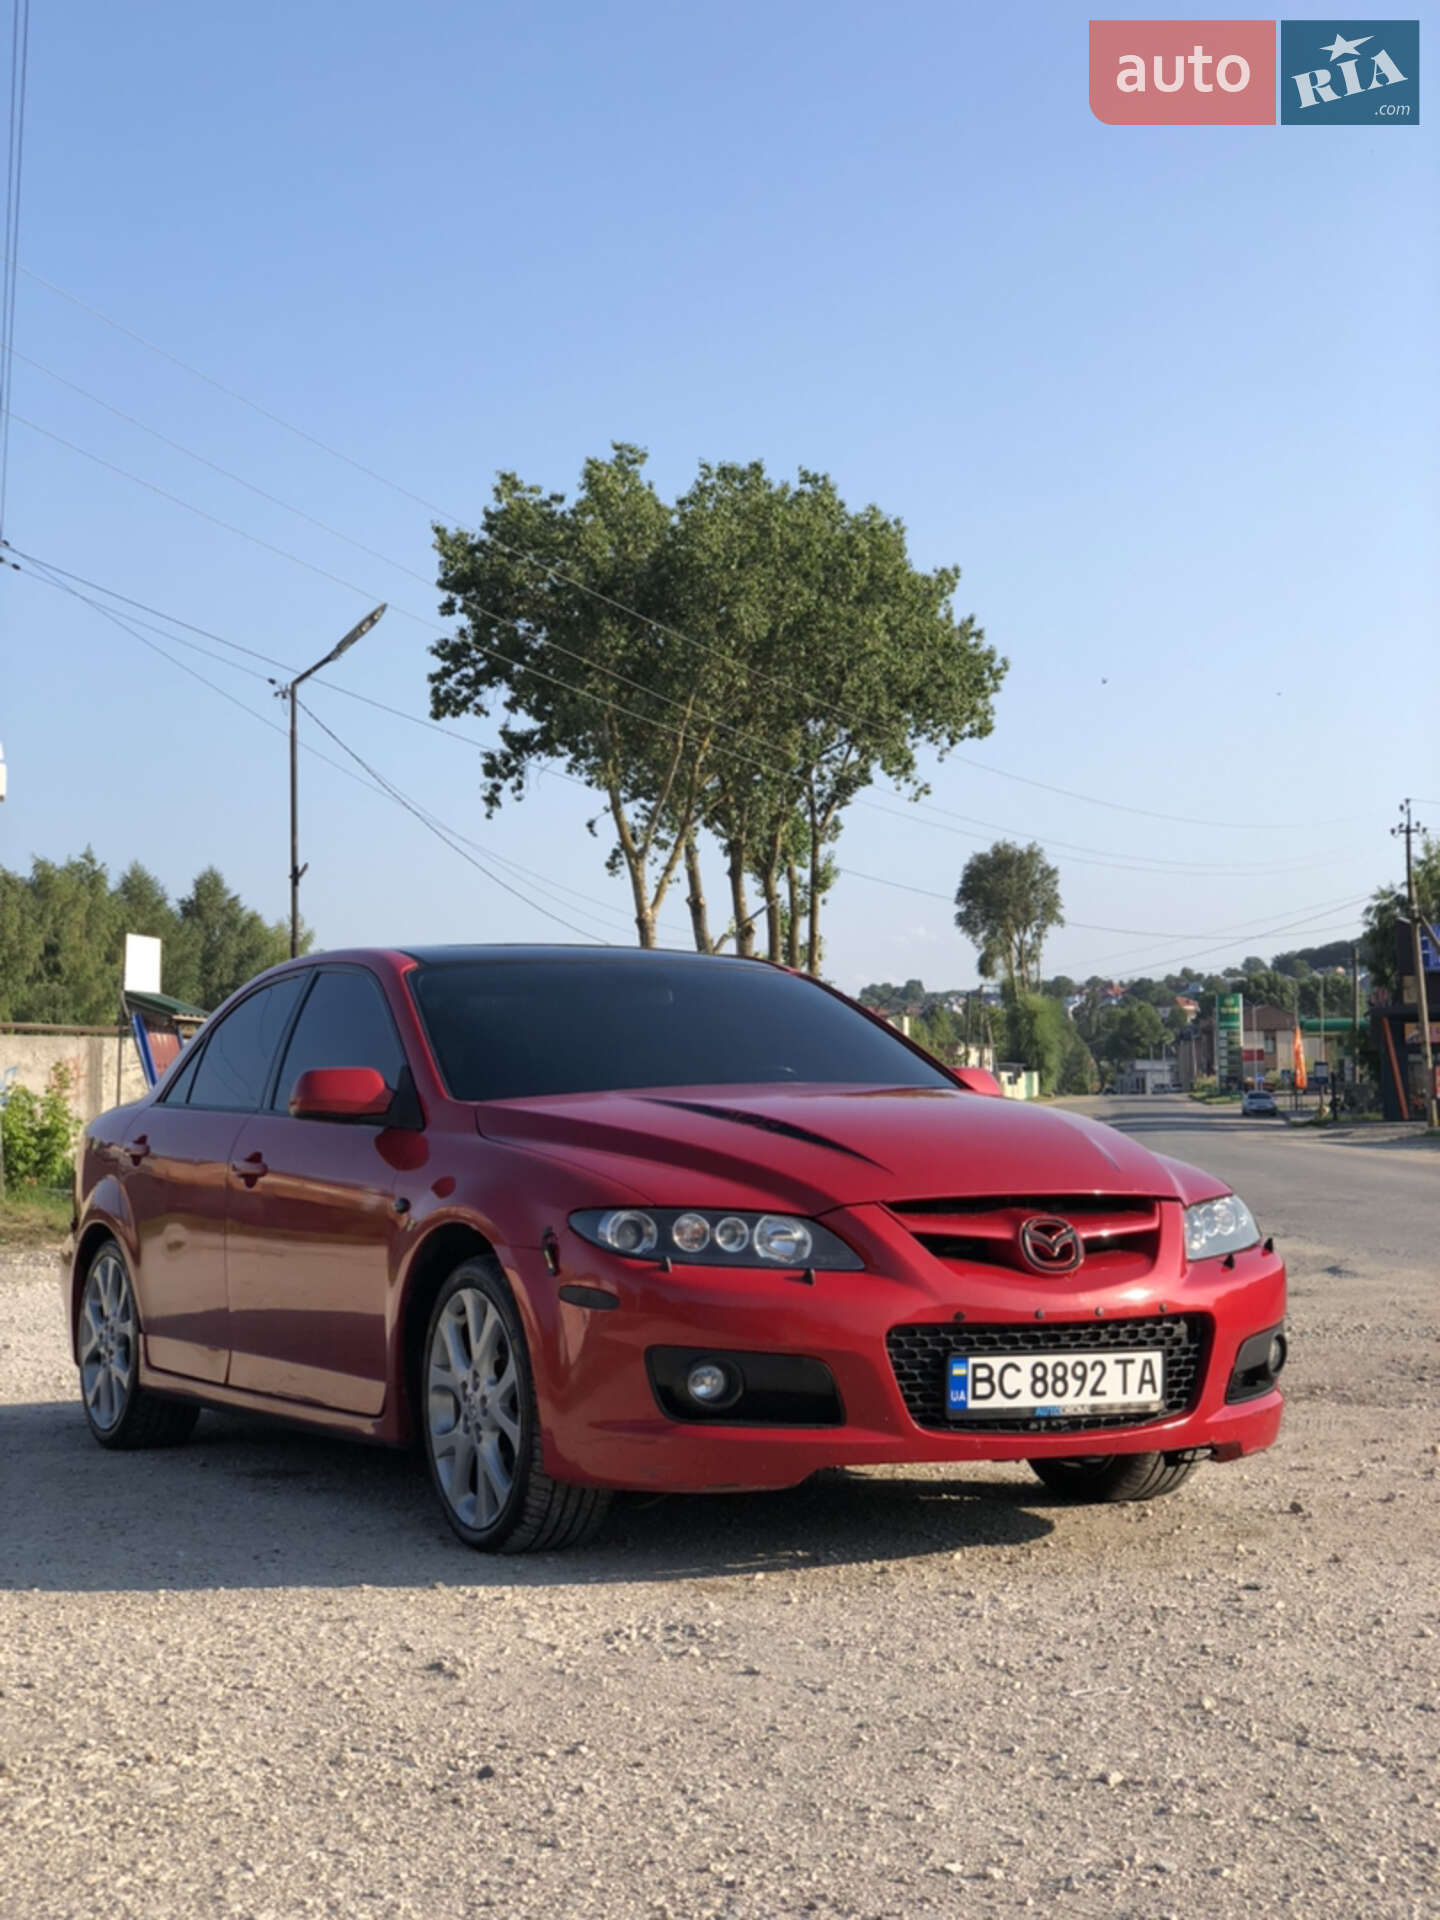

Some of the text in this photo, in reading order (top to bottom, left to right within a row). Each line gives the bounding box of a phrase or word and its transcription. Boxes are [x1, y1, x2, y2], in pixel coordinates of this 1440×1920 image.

[970, 1359, 1157, 1401] BC 8892 TA
[951, 1390, 966, 1402] UA
